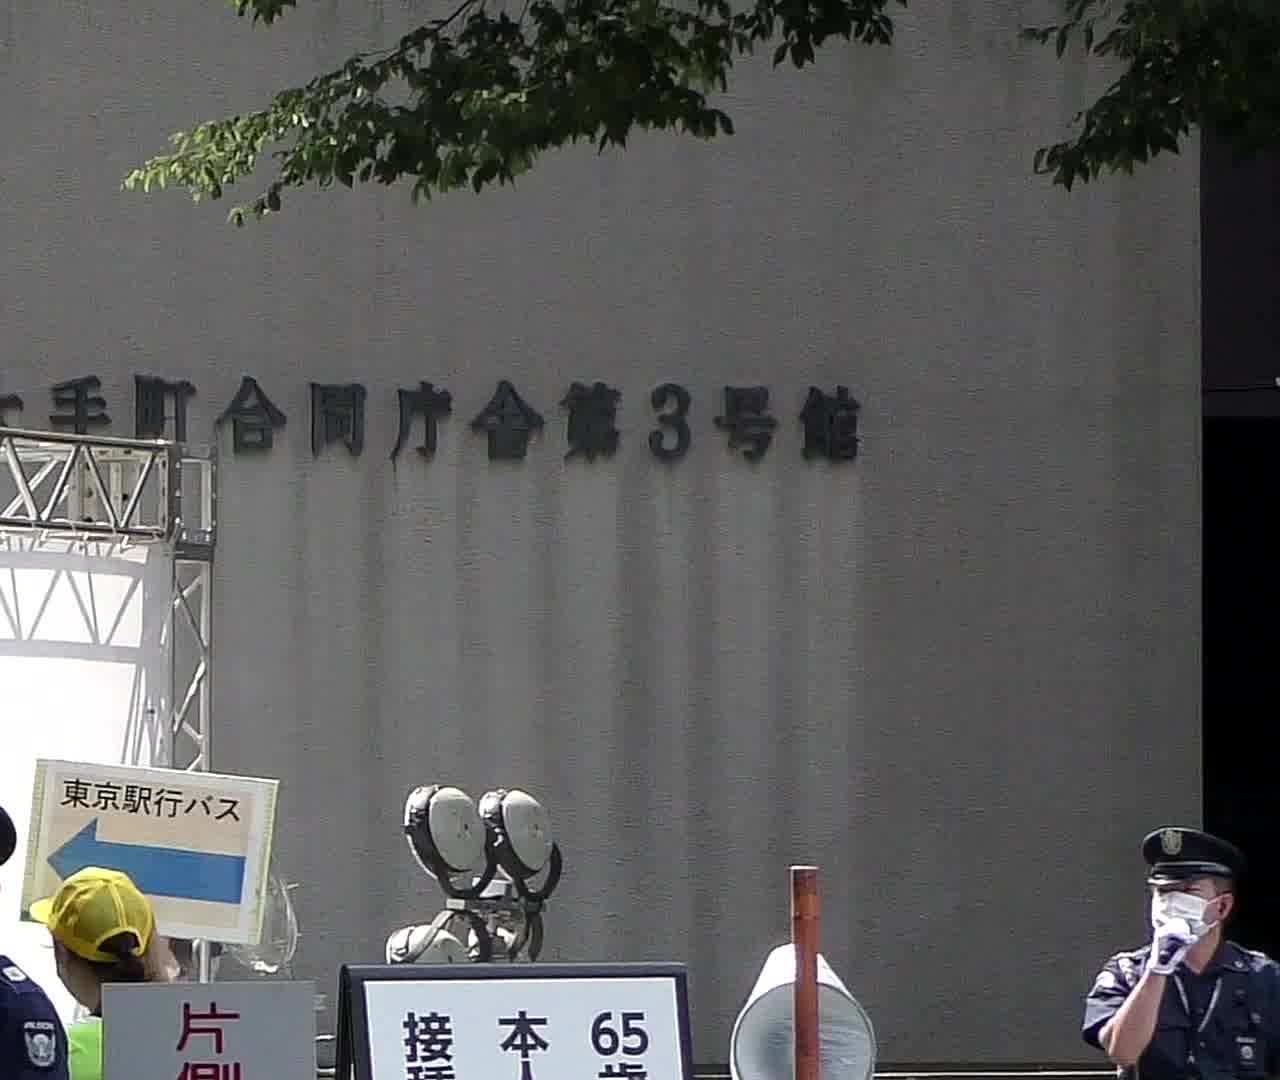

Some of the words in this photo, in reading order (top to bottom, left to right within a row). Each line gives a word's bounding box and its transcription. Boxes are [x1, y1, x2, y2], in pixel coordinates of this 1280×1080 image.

[60, 777, 241, 821] 東京駅行バス
